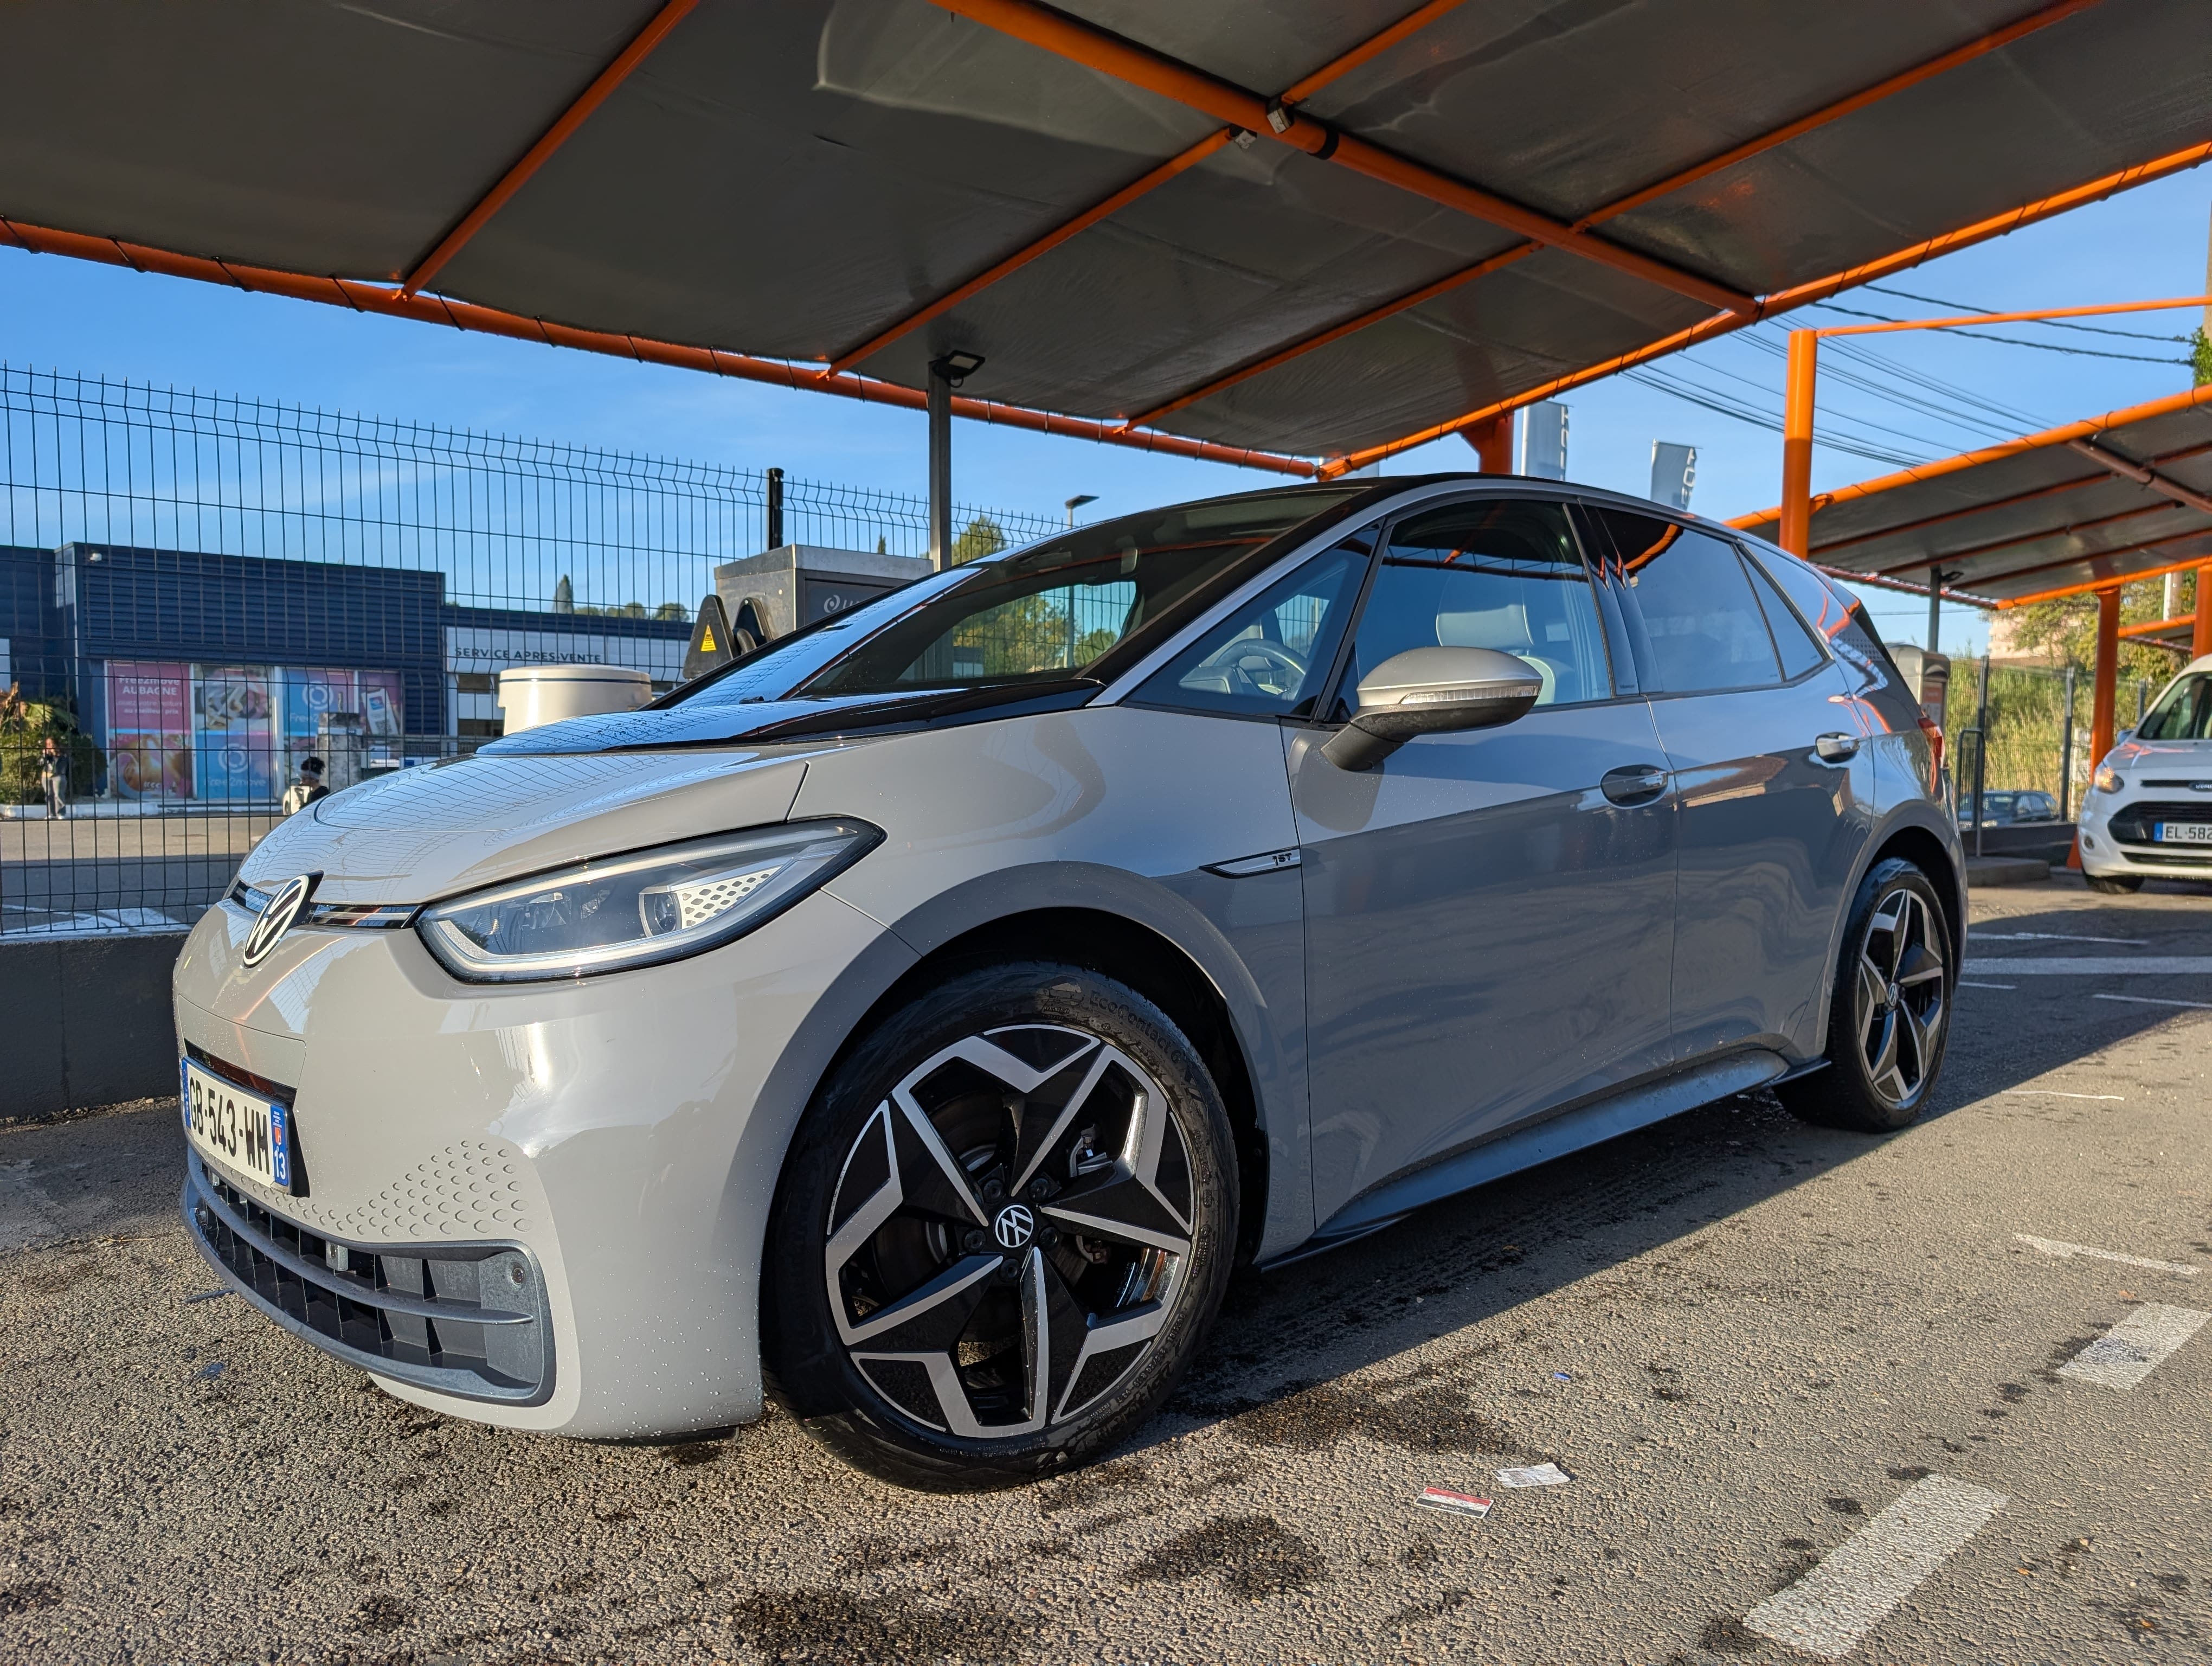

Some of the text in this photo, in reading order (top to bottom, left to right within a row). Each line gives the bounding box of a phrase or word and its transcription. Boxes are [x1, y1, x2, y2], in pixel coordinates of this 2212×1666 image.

[123, 686, 177, 695] AUBAGNE
[1272, 853, 1292, 866] 1ST
[190, 1077, 270, 1175] GB-543-WM
[274, 1150, 286, 1180] 13
